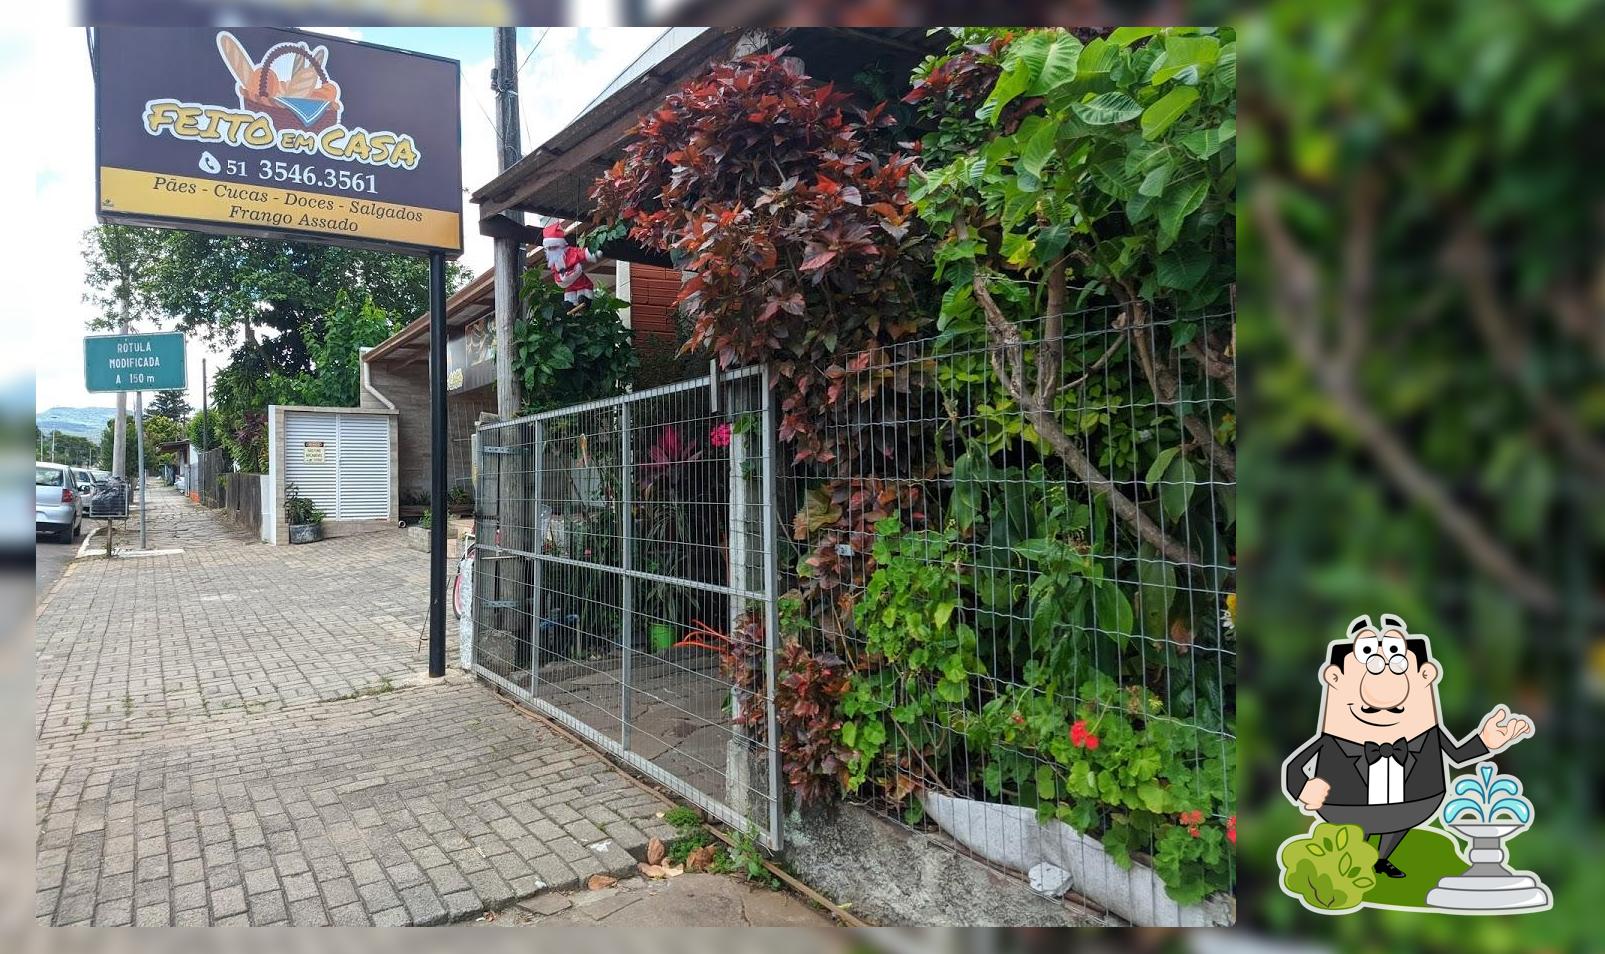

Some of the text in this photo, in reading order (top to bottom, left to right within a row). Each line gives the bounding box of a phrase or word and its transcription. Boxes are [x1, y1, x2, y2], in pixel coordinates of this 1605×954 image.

[145, 101, 419, 168] FEITO EM CASA
[226, 159, 378, 194] 51 3546.3561
[153, 176, 197, 194] Pães
[214, 184, 268, 203] Cucas
[284, 192, 334, 211] Doces
[349, 200, 423, 222] Salgados
[229, 205, 359, 232] Frango Assado
[109, 356, 160, 369] MODIFICADA
[115, 373, 155, 384] A 150 m
